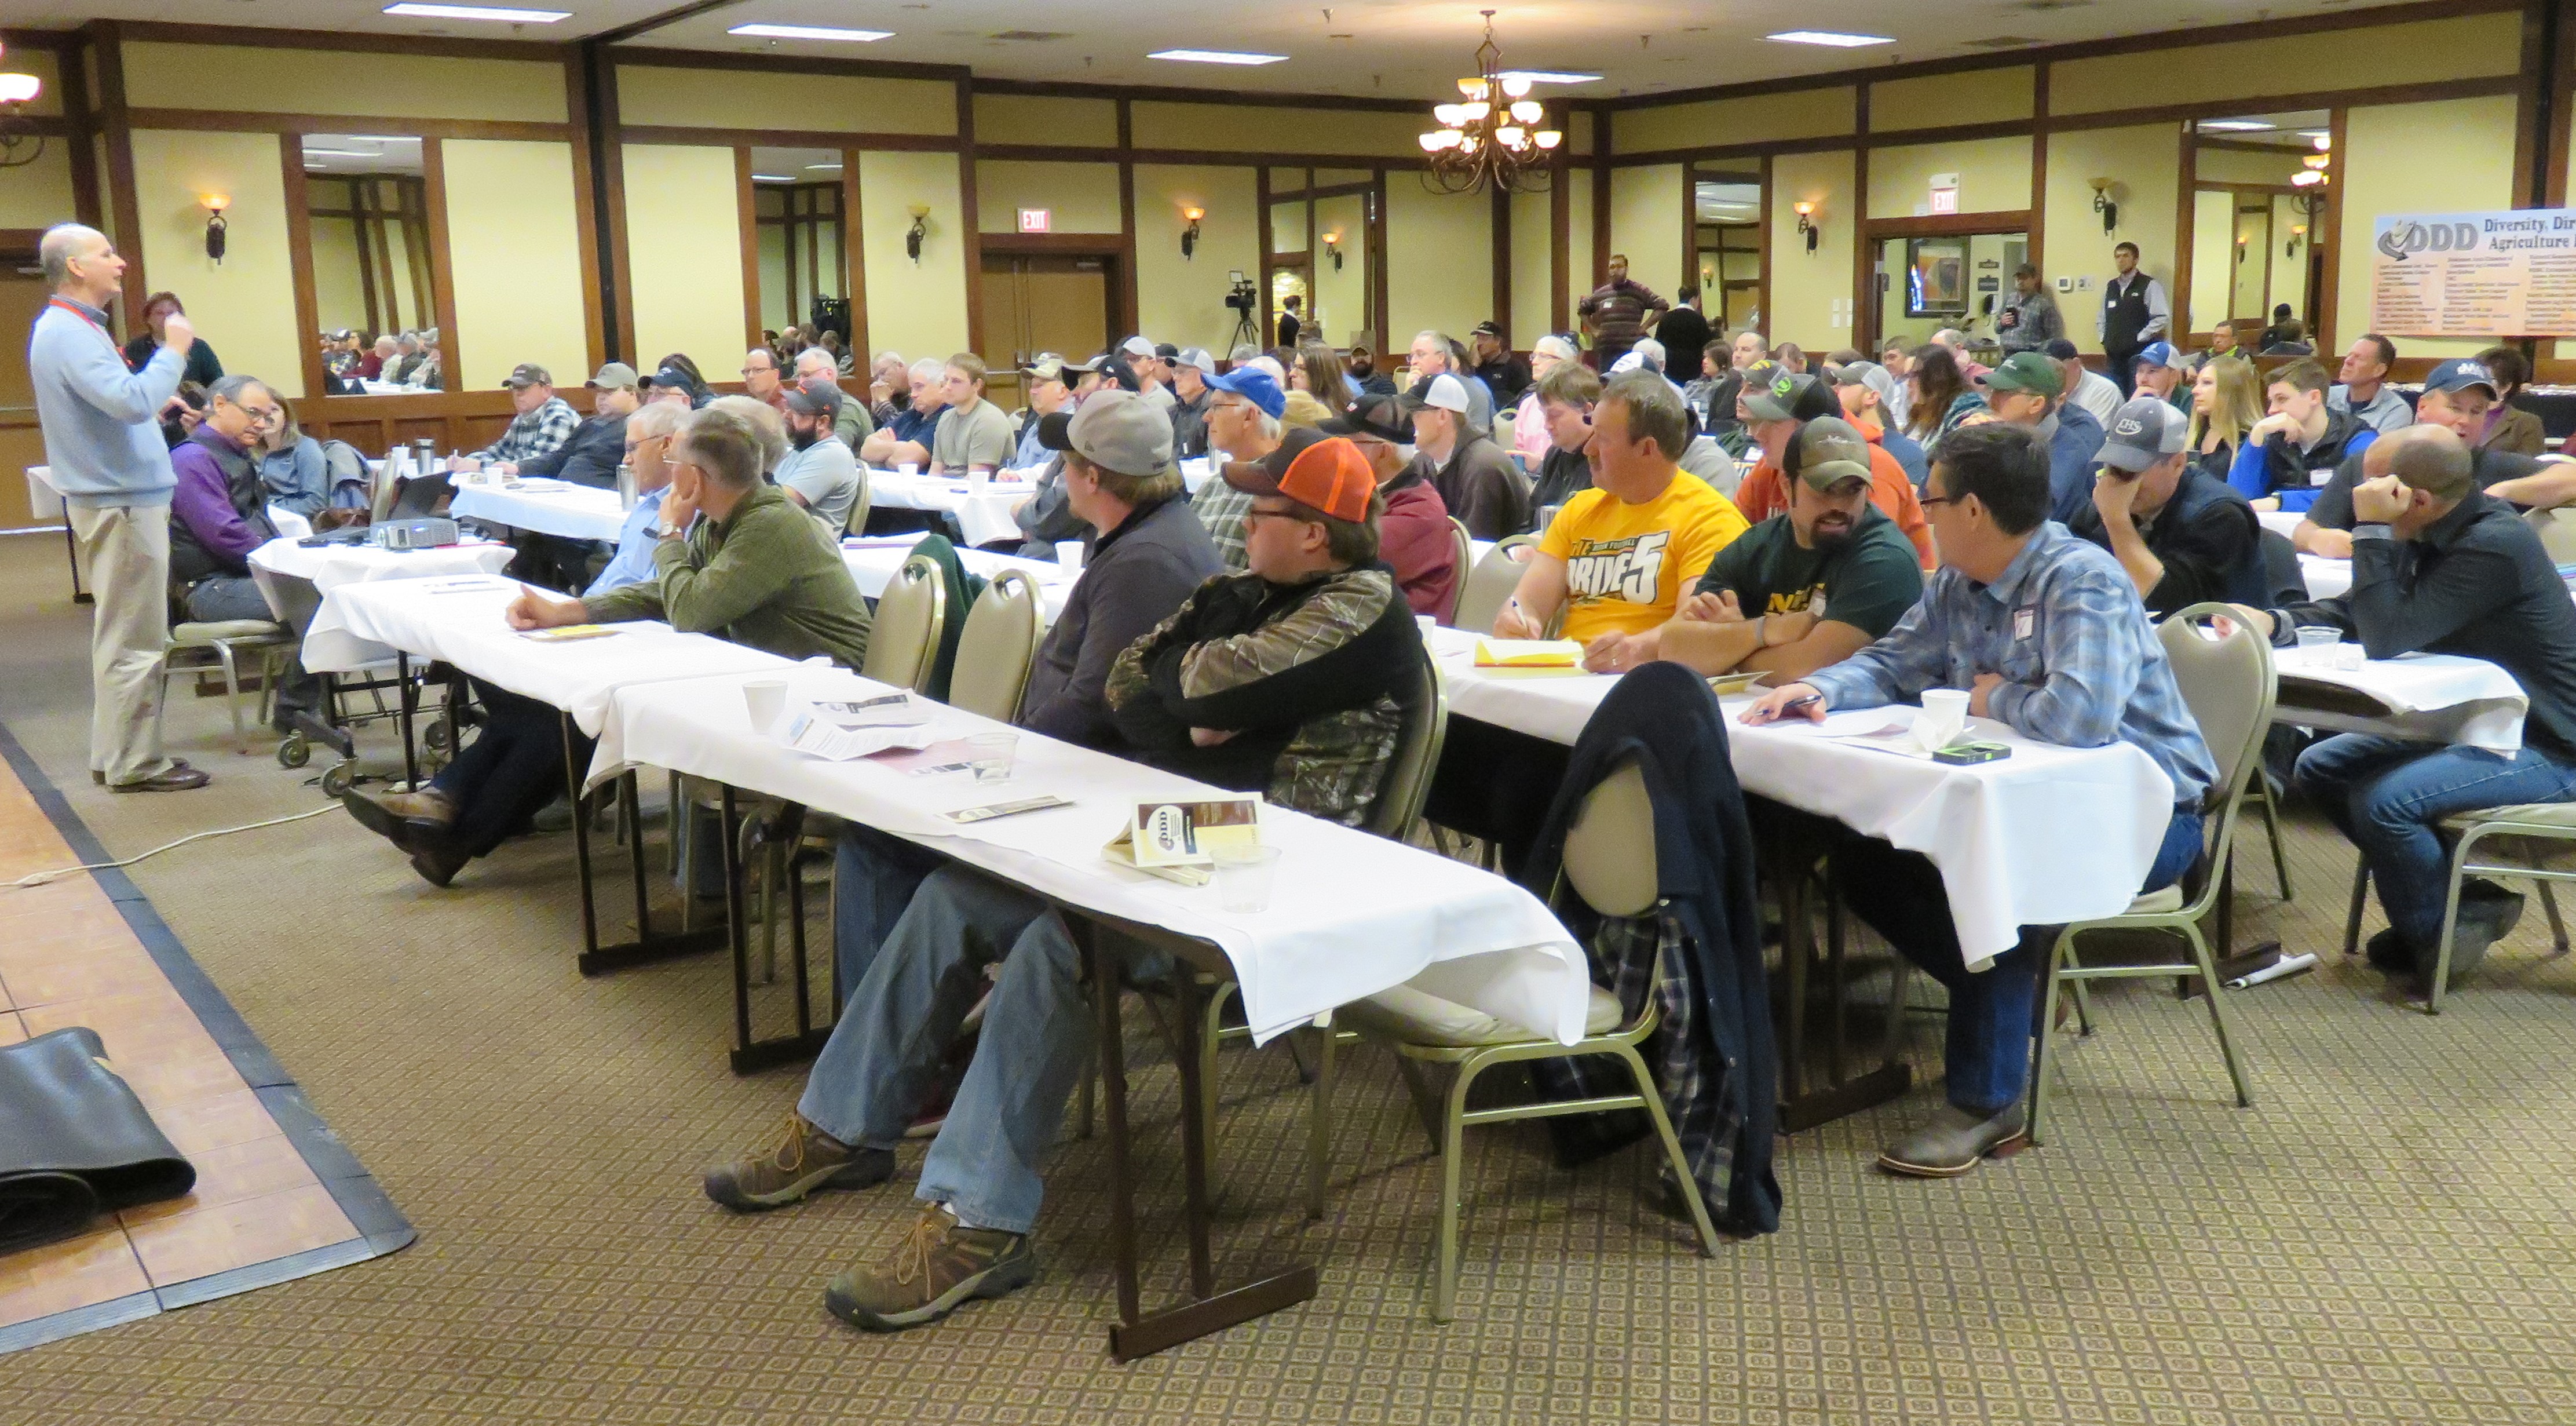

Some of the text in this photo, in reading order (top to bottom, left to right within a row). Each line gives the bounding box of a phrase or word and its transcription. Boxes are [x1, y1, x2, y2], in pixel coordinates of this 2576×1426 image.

[1935, 192, 1956, 210] EXIT
[1024, 211, 1045, 229] EXIT
[2484, 217, 2548, 233] Diversity,
[2489, 235, 2570, 252] Agriculture
